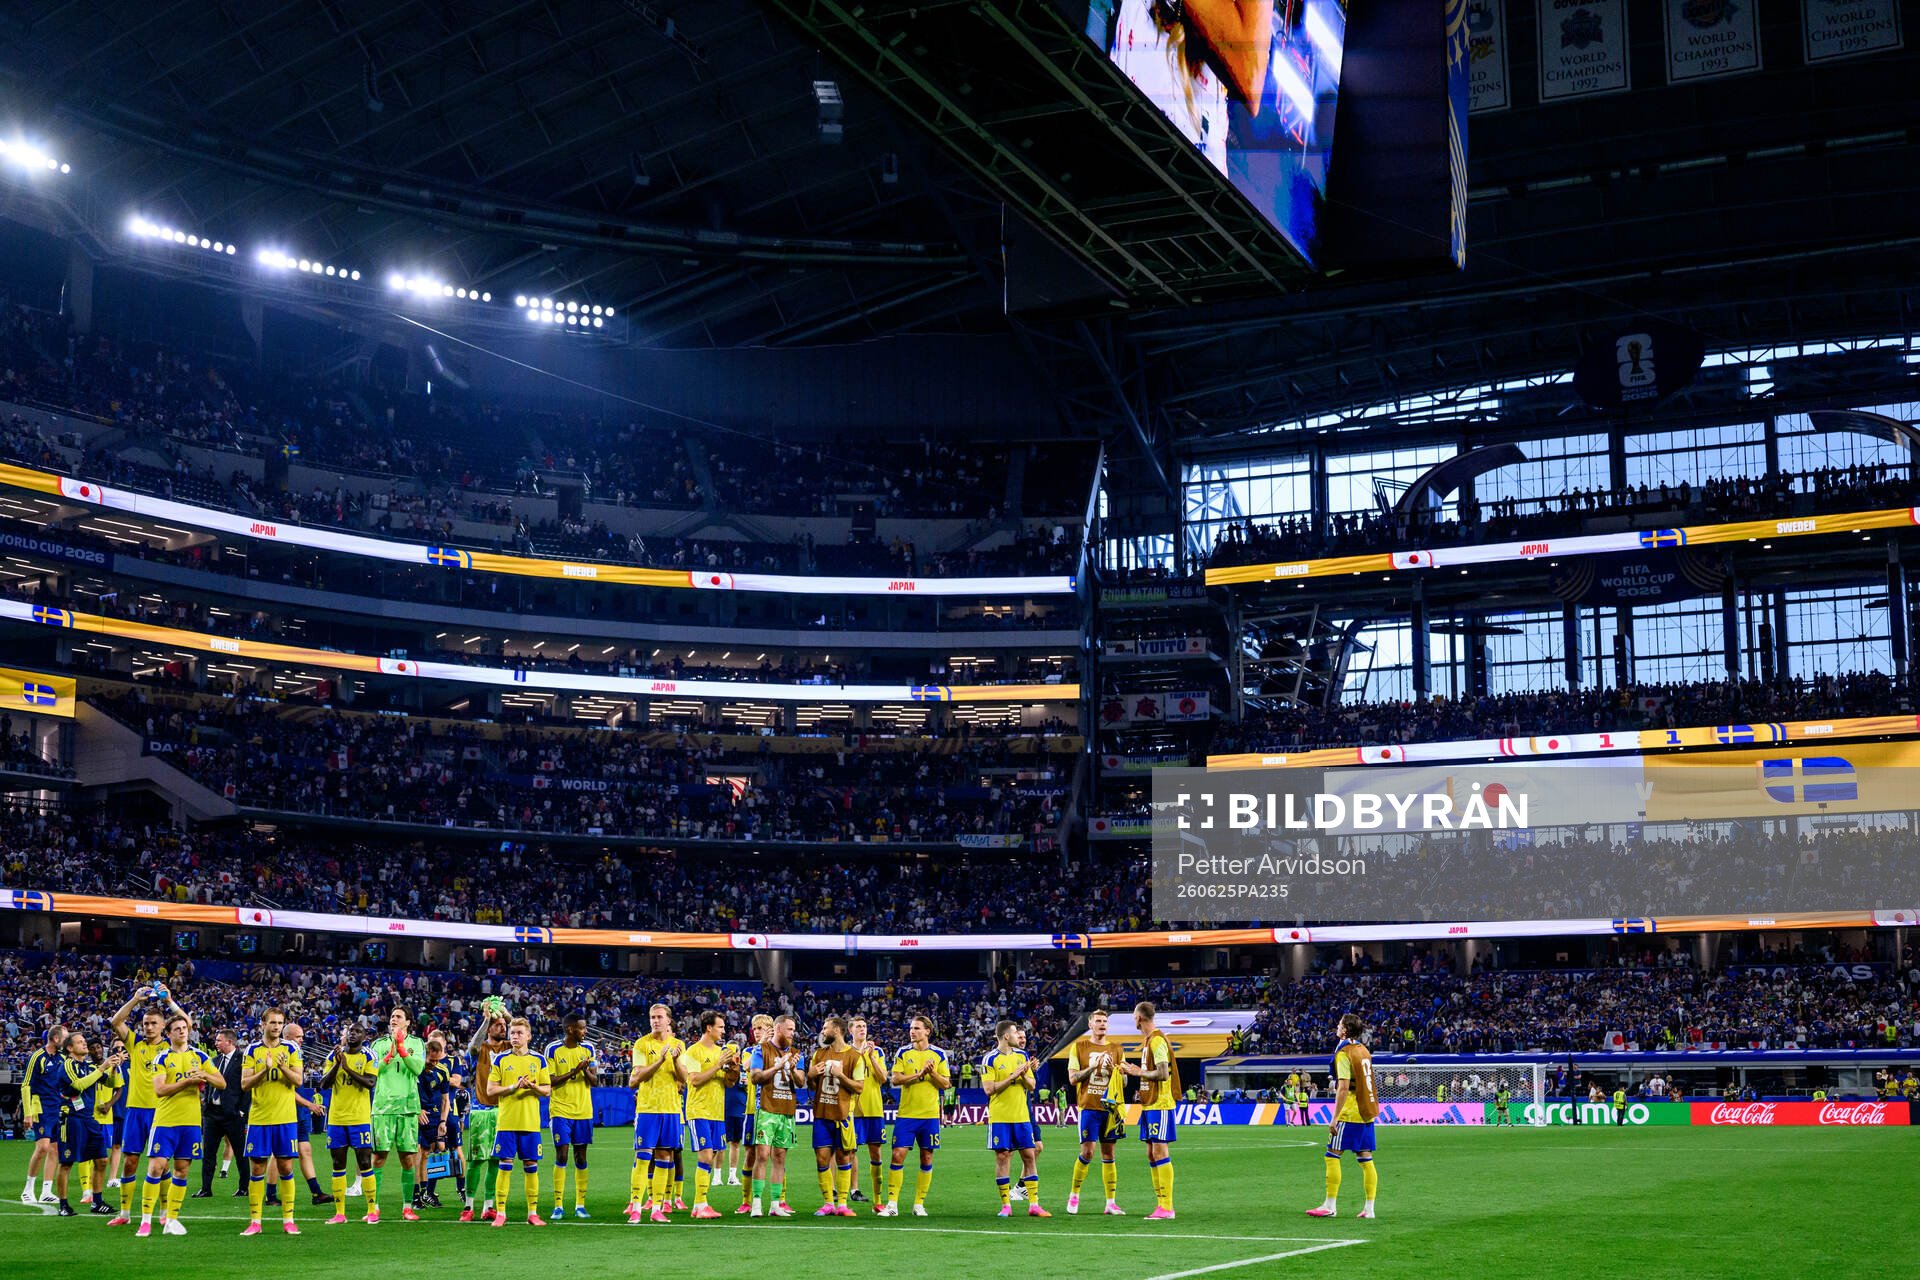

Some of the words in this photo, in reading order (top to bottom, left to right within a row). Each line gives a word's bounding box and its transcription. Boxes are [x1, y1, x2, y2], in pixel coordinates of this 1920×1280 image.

[1825, 9, 1876, 25] WORLD
[1811, 19, 1893, 42] CHAMPIONS
[1688, 31, 1737, 46] WORLD
[1559, 51, 1607, 65] WORLD
[1673, 41, 1753, 63] CHAMPIONS
[1546, 63, 1622, 82] CHAMPIONS
[1571, 77, 1599, 91] 1992
[250, 522, 277, 537] JAPAN
[1777, 520, 1816, 534] SWEDEN
[40, 542, 63, 555] CUP
[65, 547, 105, 563] 2026
[1520, 543, 1549, 556] JAPAN
[562, 565, 597, 578] SWEDEN
[1275, 564, 1309, 577] SWEDEN
[1622, 564, 1651, 575] FIFA
[887, 581, 915, 591] JAPAN
[1601, 576, 1647, 587] WORLD
[1649, 573, 1675, 585] CUP
[1616, 586, 1662, 597] 2026
[210, 638, 239, 653] SWEDEN
[1139, 639, 1187, 655] YUITO
[651, 682, 676, 692] JAPAN
[1599, 734, 1615, 748] 1
[1666, 730, 1682, 745] 1
[561, 779, 608, 791] WORLD
[388, 922, 405, 931] JAPAN
[1448, 926, 1468, 934] JAPAN
[396, 1060, 400, 1074] 1
[1175, 1104, 1223, 1125] VISA
[1523, 1103, 1650, 1125] aramco
[1711, 1103, 1777, 1125] Coca-Cola
[1819, 1103, 1888, 1125] Coca-Cola
[359, 1131, 371, 1146] 13
[929, 1132, 941, 1147] 15
[536, 1143, 543, 1157] 8
